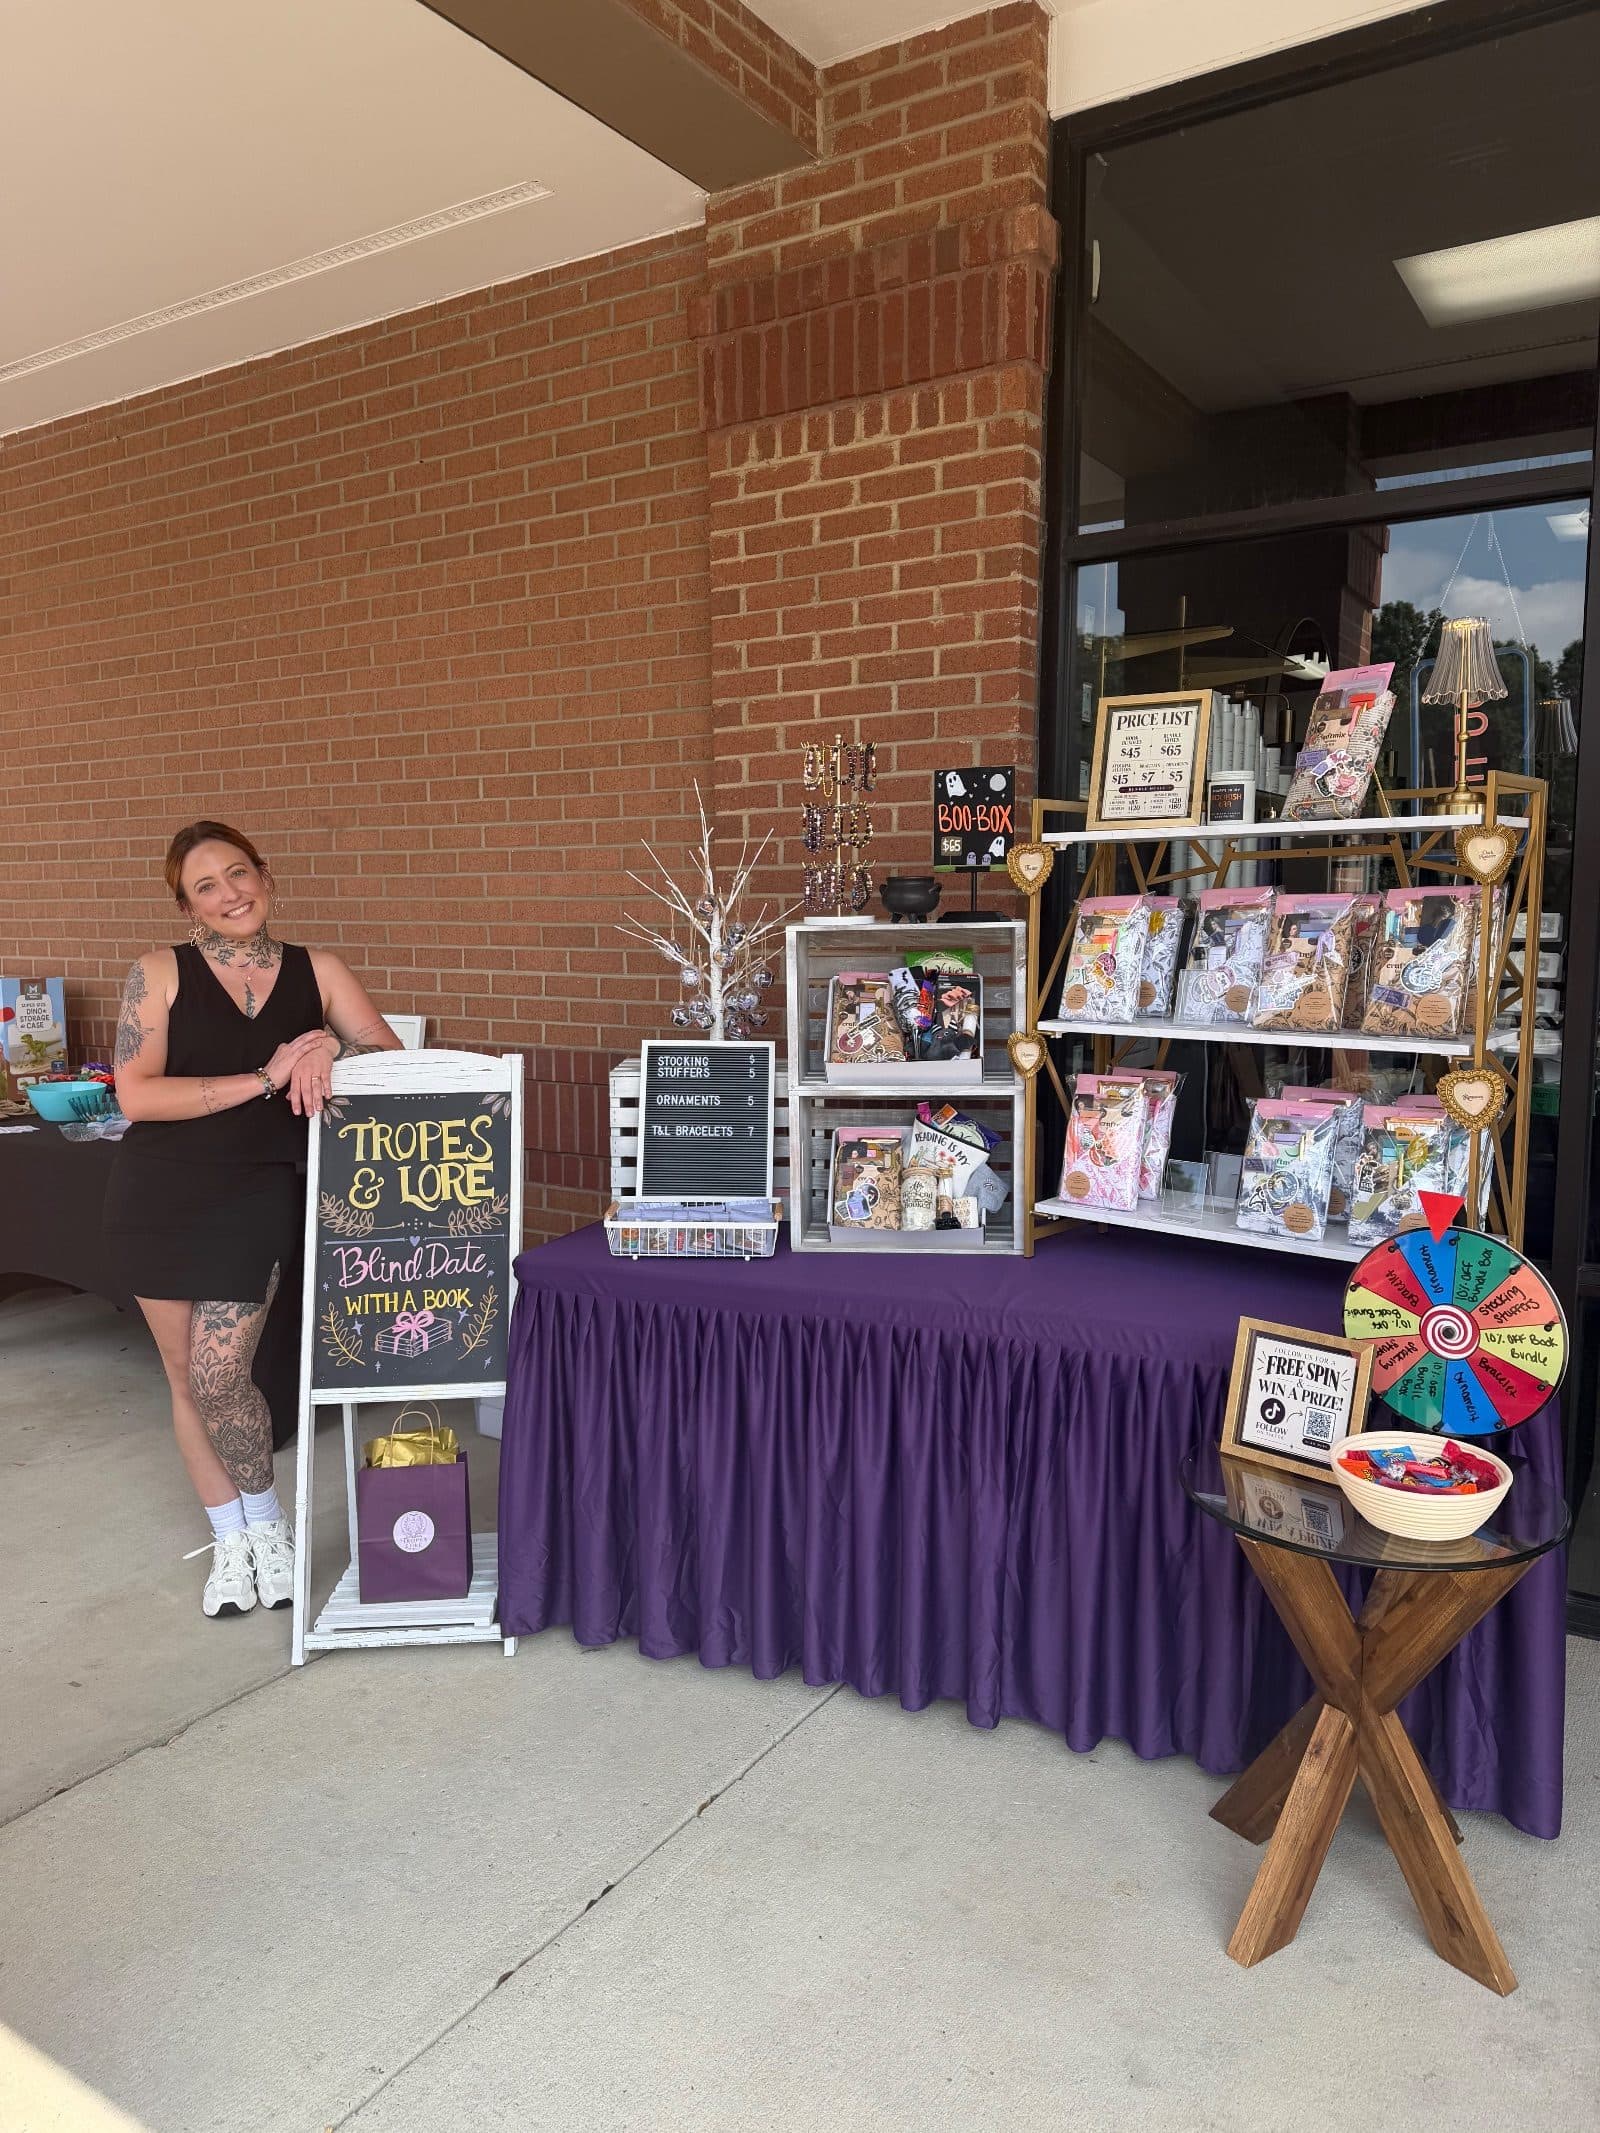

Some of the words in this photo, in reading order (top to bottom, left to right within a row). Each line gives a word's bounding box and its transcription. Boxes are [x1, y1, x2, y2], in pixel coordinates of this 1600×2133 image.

[1117, 712, 1159, 731] PRICE
[1162, 710, 1193, 726] LIST
[1120, 747, 1141, 759] $45
[1160, 744, 1182, 756] $65
[1111, 774, 1129, 786] $15
[1141, 771, 1156, 783] $7
[1169, 770, 1183, 782] $5
[938, 803, 1013, 834] BOO-BOX
[942, 838, 961, 852] $65
[657, 1056, 709, 1067] STOCKING
[657, 1067, 710, 1078] STUFFERS
[749, 1068, 756, 1078] 5
[656, 1095, 721, 1106] ORNAMENTS
[747, 1096, 754, 1106] 5
[338, 1115, 493, 1162] TROPES
[651, 1125, 671, 1136] T&L
[676, 1126, 733, 1136] BRACELETS
[747, 1127, 754, 1136] 7
[915, 1131, 947, 1147] READING
[947, 1142, 957, 1153] IS
[955, 1150, 970, 1166] MY
[349, 1167, 384, 1210] &
[397, 1161, 494, 1211] LORE
[333, 1246, 423, 1288] Blind
[426, 1241, 487, 1279] Date
[344, 1292, 399, 1315] WITH
[402, 1291, 418, 1312] A
[423, 1288, 473, 1310] BOOK
[1511, 1348, 1548, 1366] Bundle
[1265, 1356, 1305, 1377] FREE
[1306, 1362, 1340, 1392] SPIN
[1478, 1357, 1518, 1398] Bracelet
[1259, 1379, 1286, 1397] WIN
[1288, 1387, 1297, 1400] A
[1301, 1389, 1344, 1411] PRIZE!
[1453, 1371, 1479, 1423] Ornament
[1256, 1421, 1288, 1435] FOLLOW
